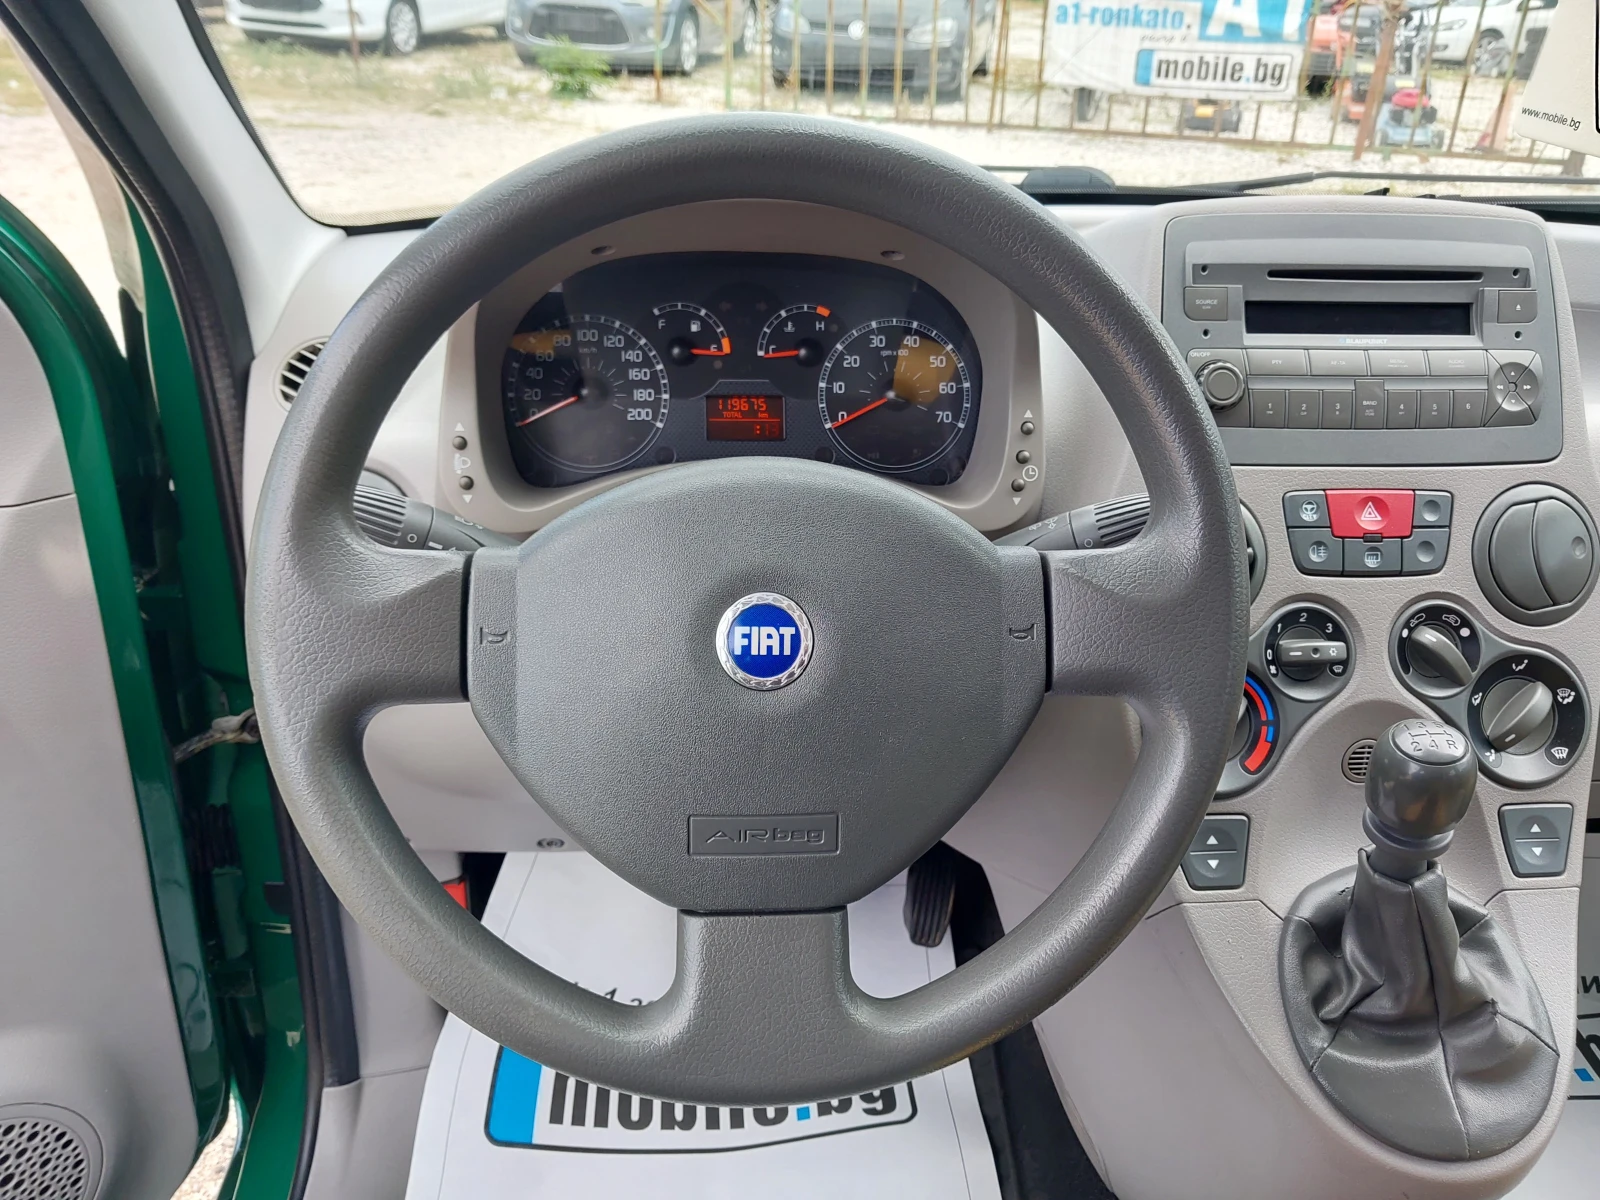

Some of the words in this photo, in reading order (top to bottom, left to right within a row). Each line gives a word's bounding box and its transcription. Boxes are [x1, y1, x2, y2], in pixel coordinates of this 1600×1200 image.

[1156, 55, 1286, 87] mobile.bg
[1521, 106, 1581, 131] www.mobile.bg
[658, 319, 666, 330] F
[815, 321, 825, 332] H
[552, 334, 572, 347] 80
[576, 329, 599, 342] 100
[603, 335, 625, 348] 120
[868, 335, 886, 348] 30
[903, 335, 920, 348] 40
[535, 350, 554, 362] 60
[620, 350, 643, 363] 140
[880, 349, 892, 357] rpm
[842, 355, 861, 368] 20
[929, 355, 947, 368] 50
[525, 367, 544, 380] 40
[628, 368, 651, 381] 160
[832, 381, 846, 394] 10
[938, 382, 957, 394] 60
[523, 388, 542, 401] 20
[632, 388, 655, 401] 180
[718, 398, 767, 411] 119675
[1301, 403, 1307, 411] 2
[1432, 403, 1438, 411] 5
[626, 408, 653, 421] 200
[723, 411, 743, 419] TOTAL
[758, 411, 769, 419] km
[935, 411, 952, 423] 70
[1299, 612, 1308, 622] 2
[1276, 623, 1282, 633] 1
[1325, 622, 1333, 633] 3
[733, 626, 796, 656] FIAT
[1410, 741, 1423, 752] 2
[1428, 739, 1439, 750] 4
[1445, 739, 1459, 750] R
